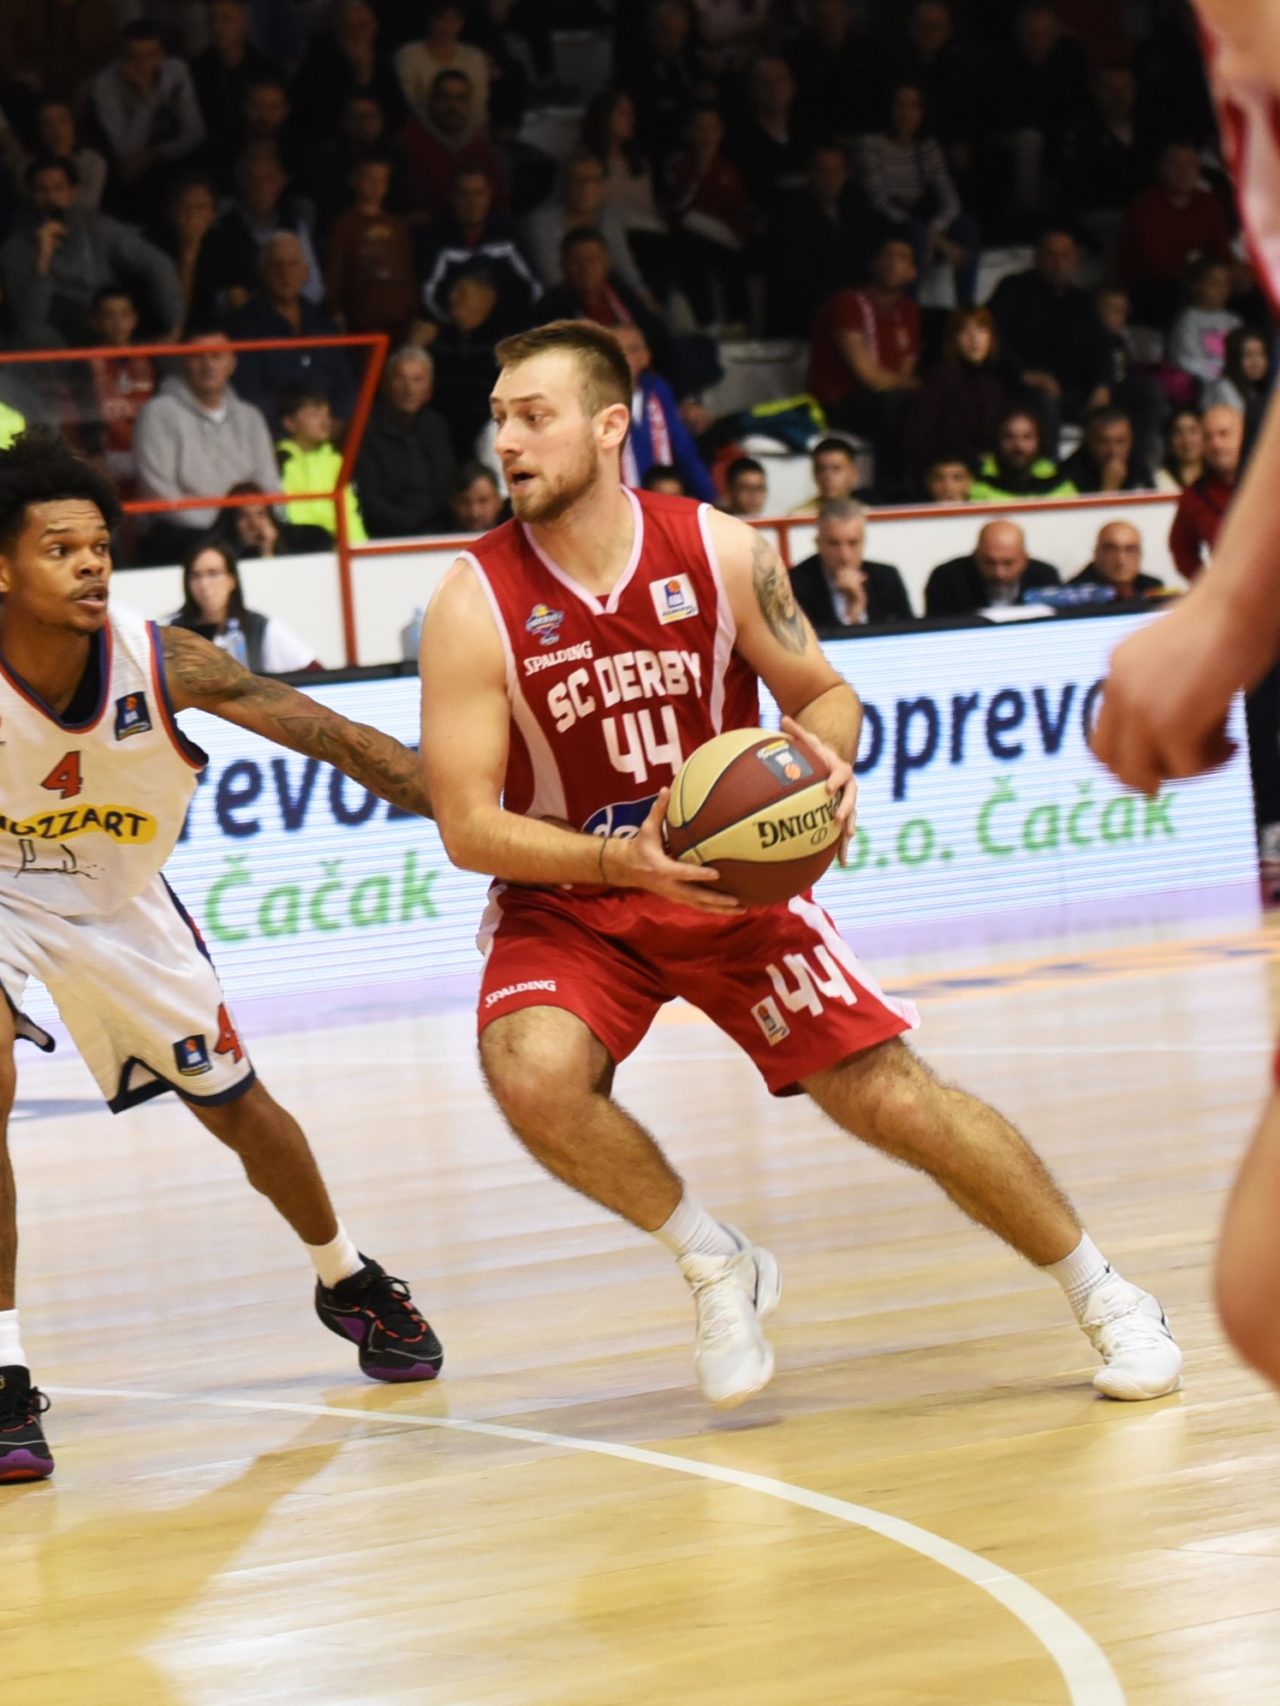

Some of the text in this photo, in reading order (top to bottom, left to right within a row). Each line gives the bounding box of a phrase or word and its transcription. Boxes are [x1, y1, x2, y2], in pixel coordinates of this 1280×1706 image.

[523, 640, 594, 677] SPALDING
[547, 650, 702, 733] SC DERBY
[40, 750, 83, 800] 4
[601, 704, 684, 785] 44
[203, 851, 441, 943] Čačak
[485, 979, 557, 1008] SPALDING
[766, 944, 858, 1017] 44
[213, 1002, 244, 1064] 4
